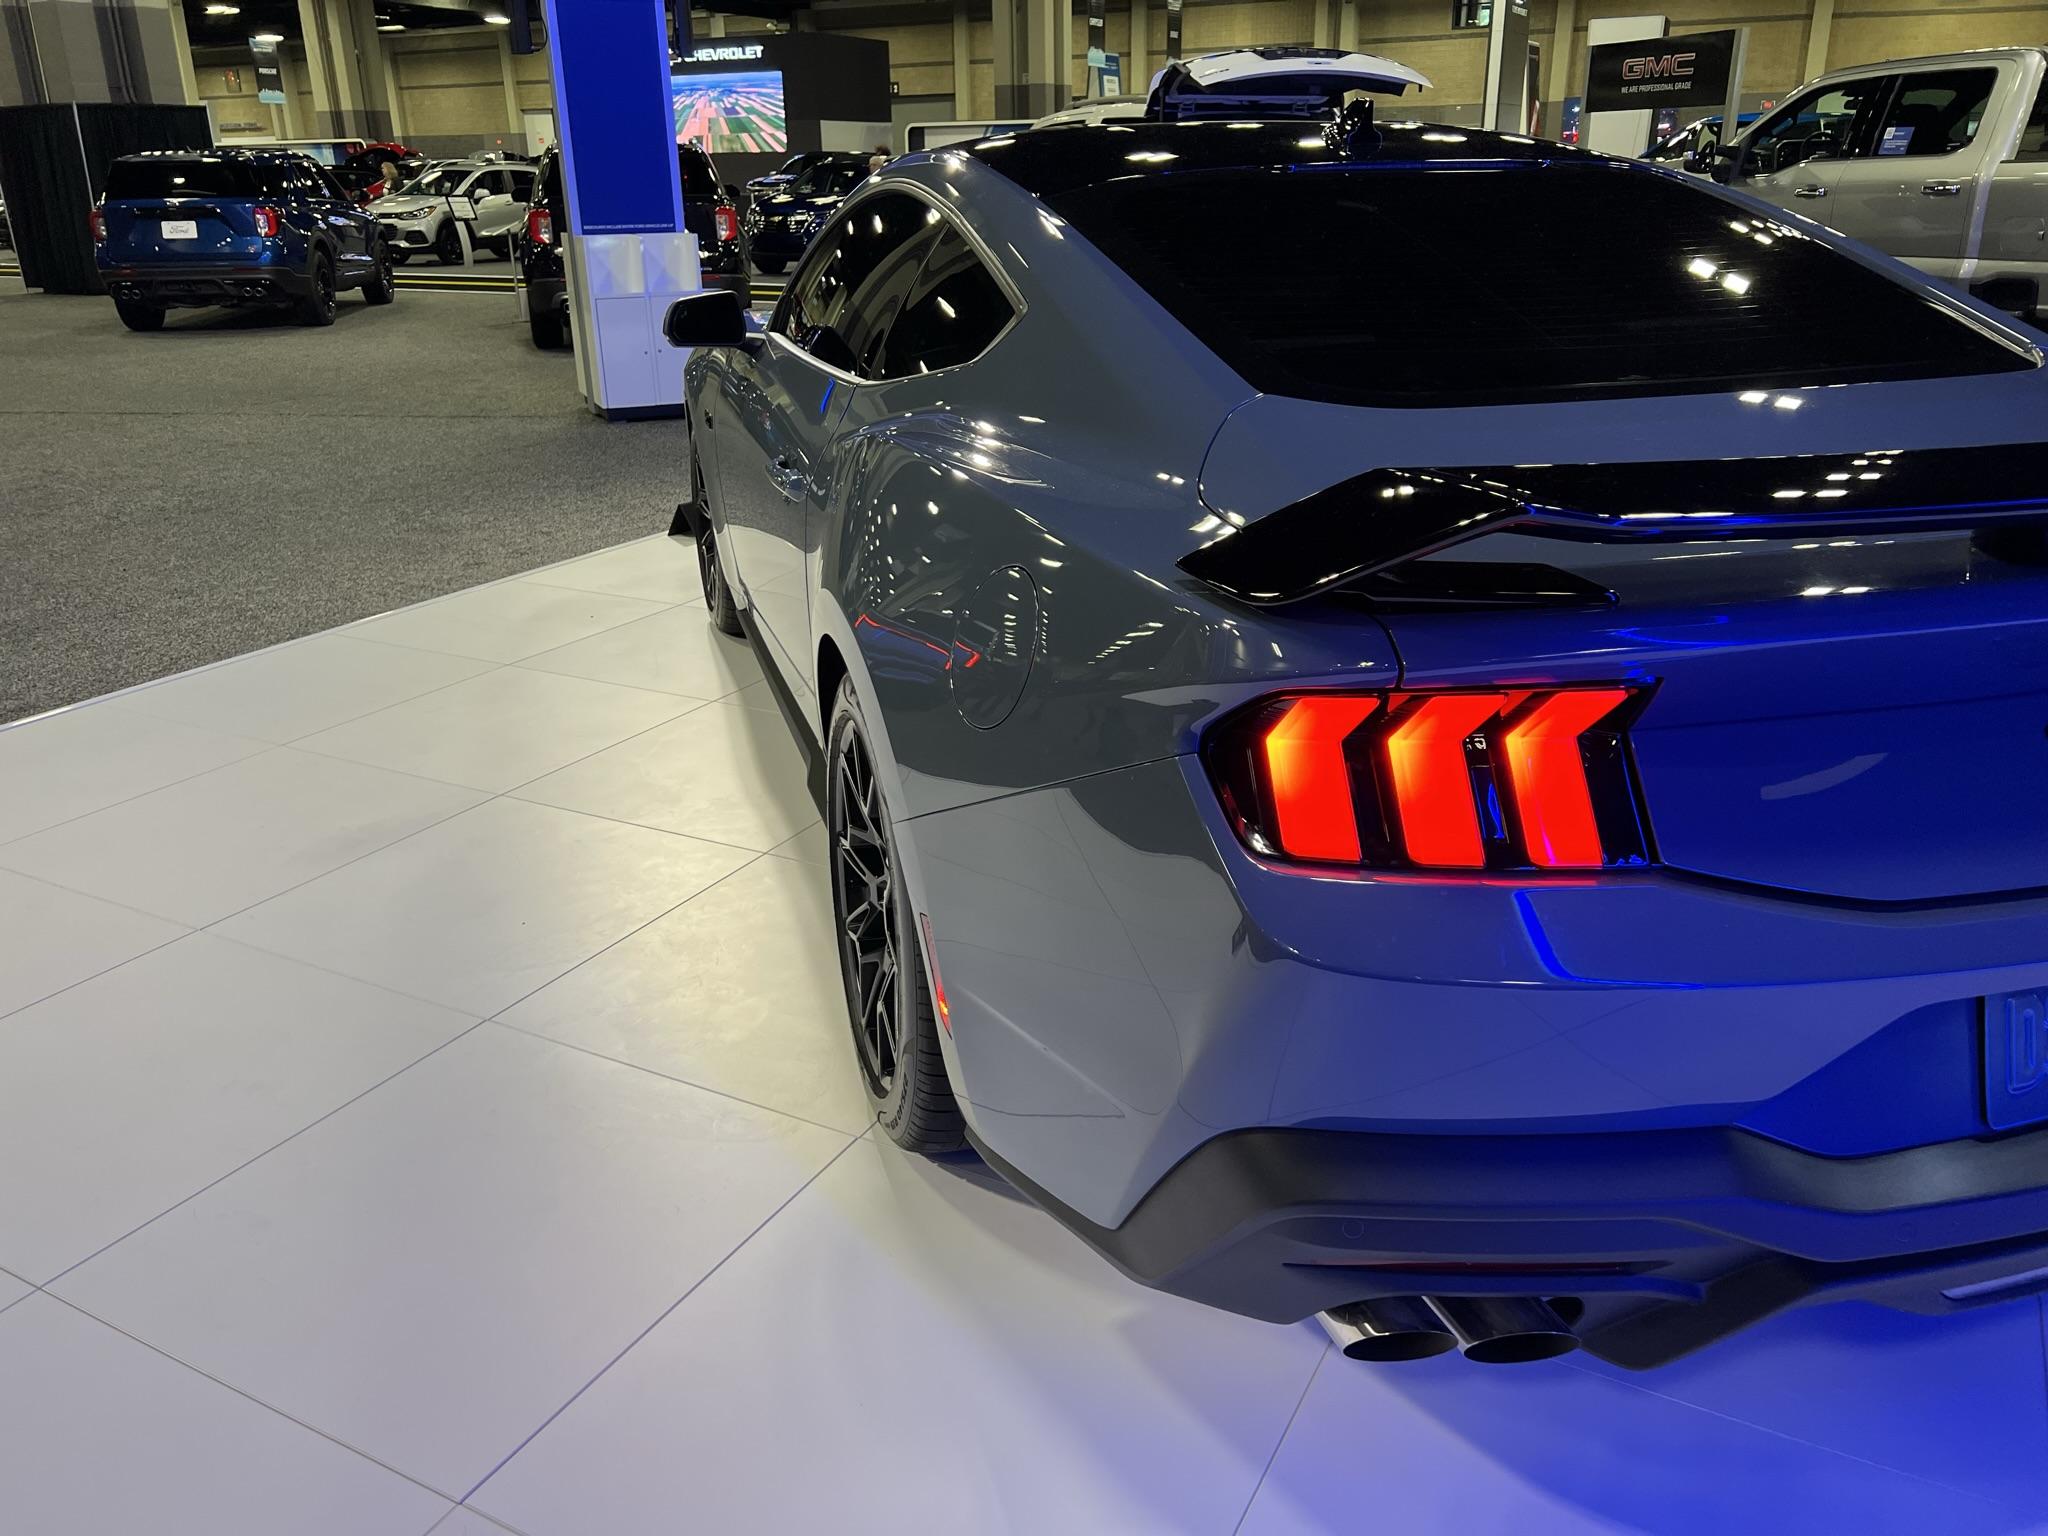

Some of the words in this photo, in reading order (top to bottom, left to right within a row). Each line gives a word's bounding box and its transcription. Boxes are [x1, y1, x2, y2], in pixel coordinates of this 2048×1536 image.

[1622, 53, 1696, 80] GMC
[1628, 85, 1639, 93] ARE
[1639, 83, 1674, 93] PROFESSIONAL
[1674, 82, 1691, 90] GRADE
[2008, 995, 2048, 1093] D
